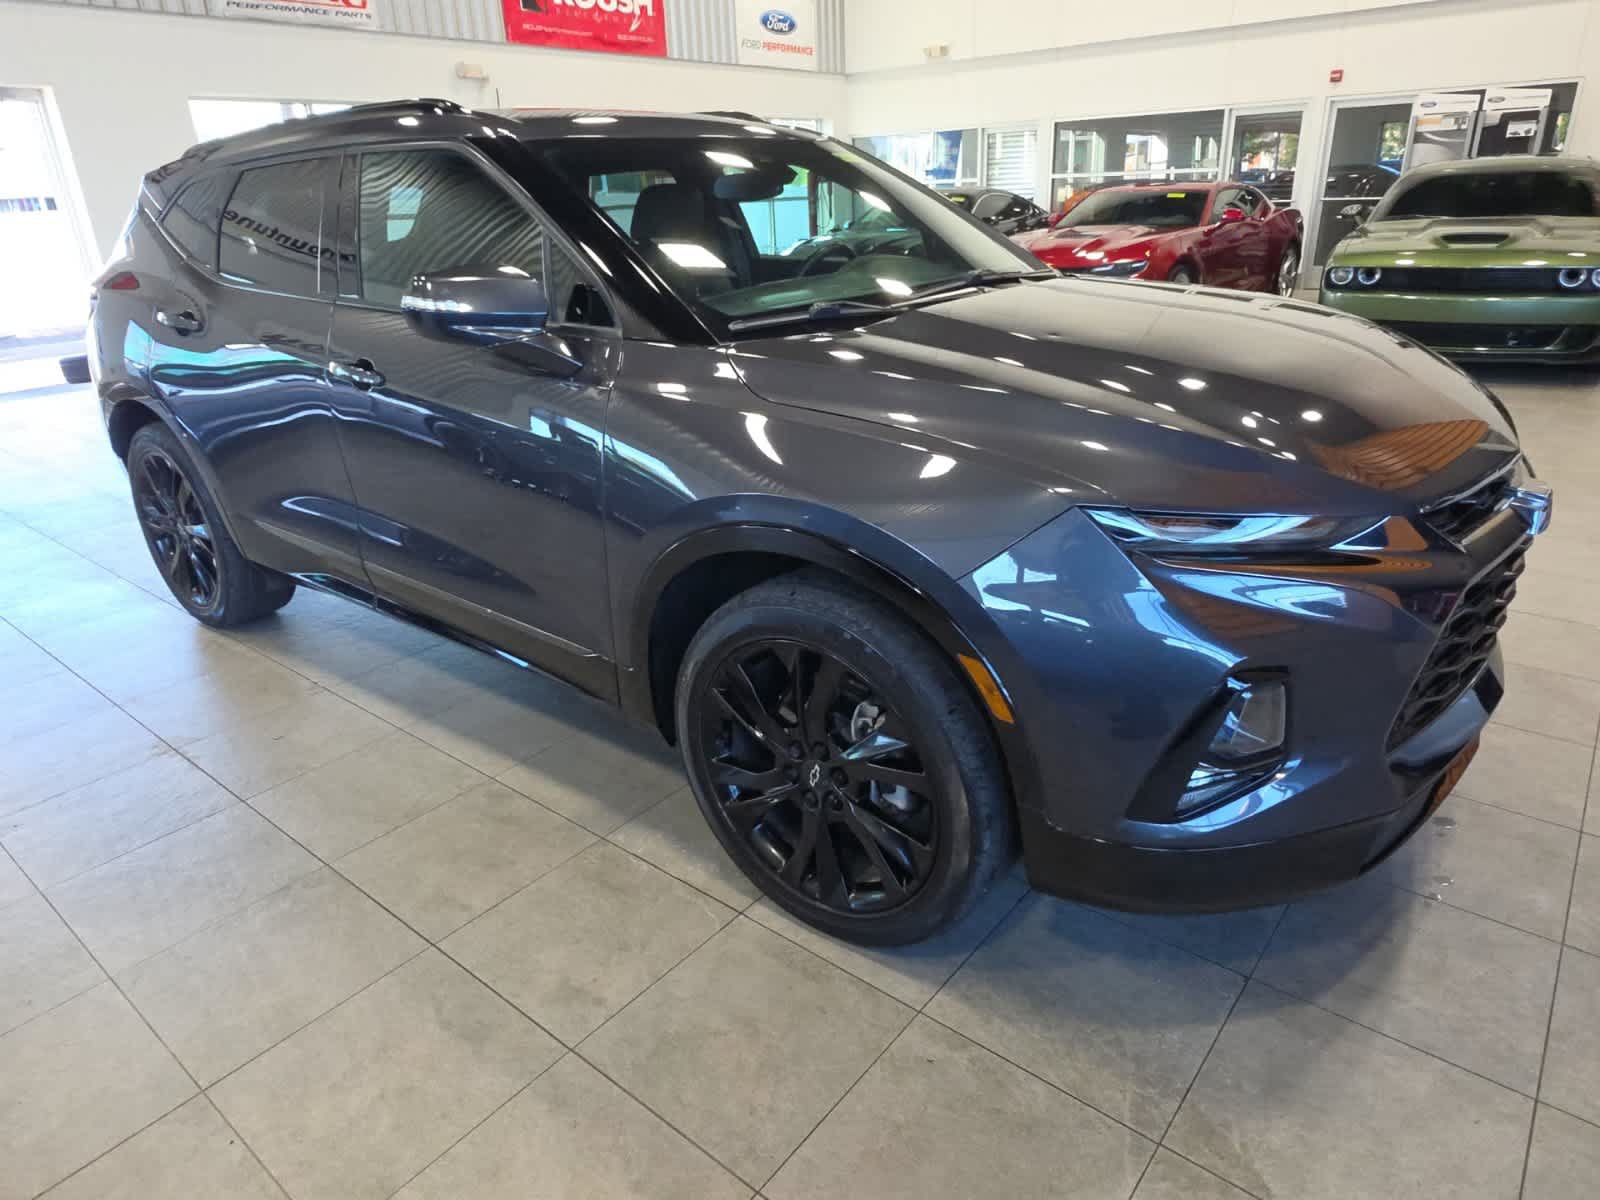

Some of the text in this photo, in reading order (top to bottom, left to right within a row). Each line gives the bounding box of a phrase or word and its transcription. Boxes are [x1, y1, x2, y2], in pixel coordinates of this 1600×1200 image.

[226, 1, 331, 16] PERFORMANCE
[335, 10, 373, 19] PARTS
[552, 0, 656, 17] USH
[767, 13, 791, 31] Ford
[741, 39, 813, 56] FORD PERFORMANCE
